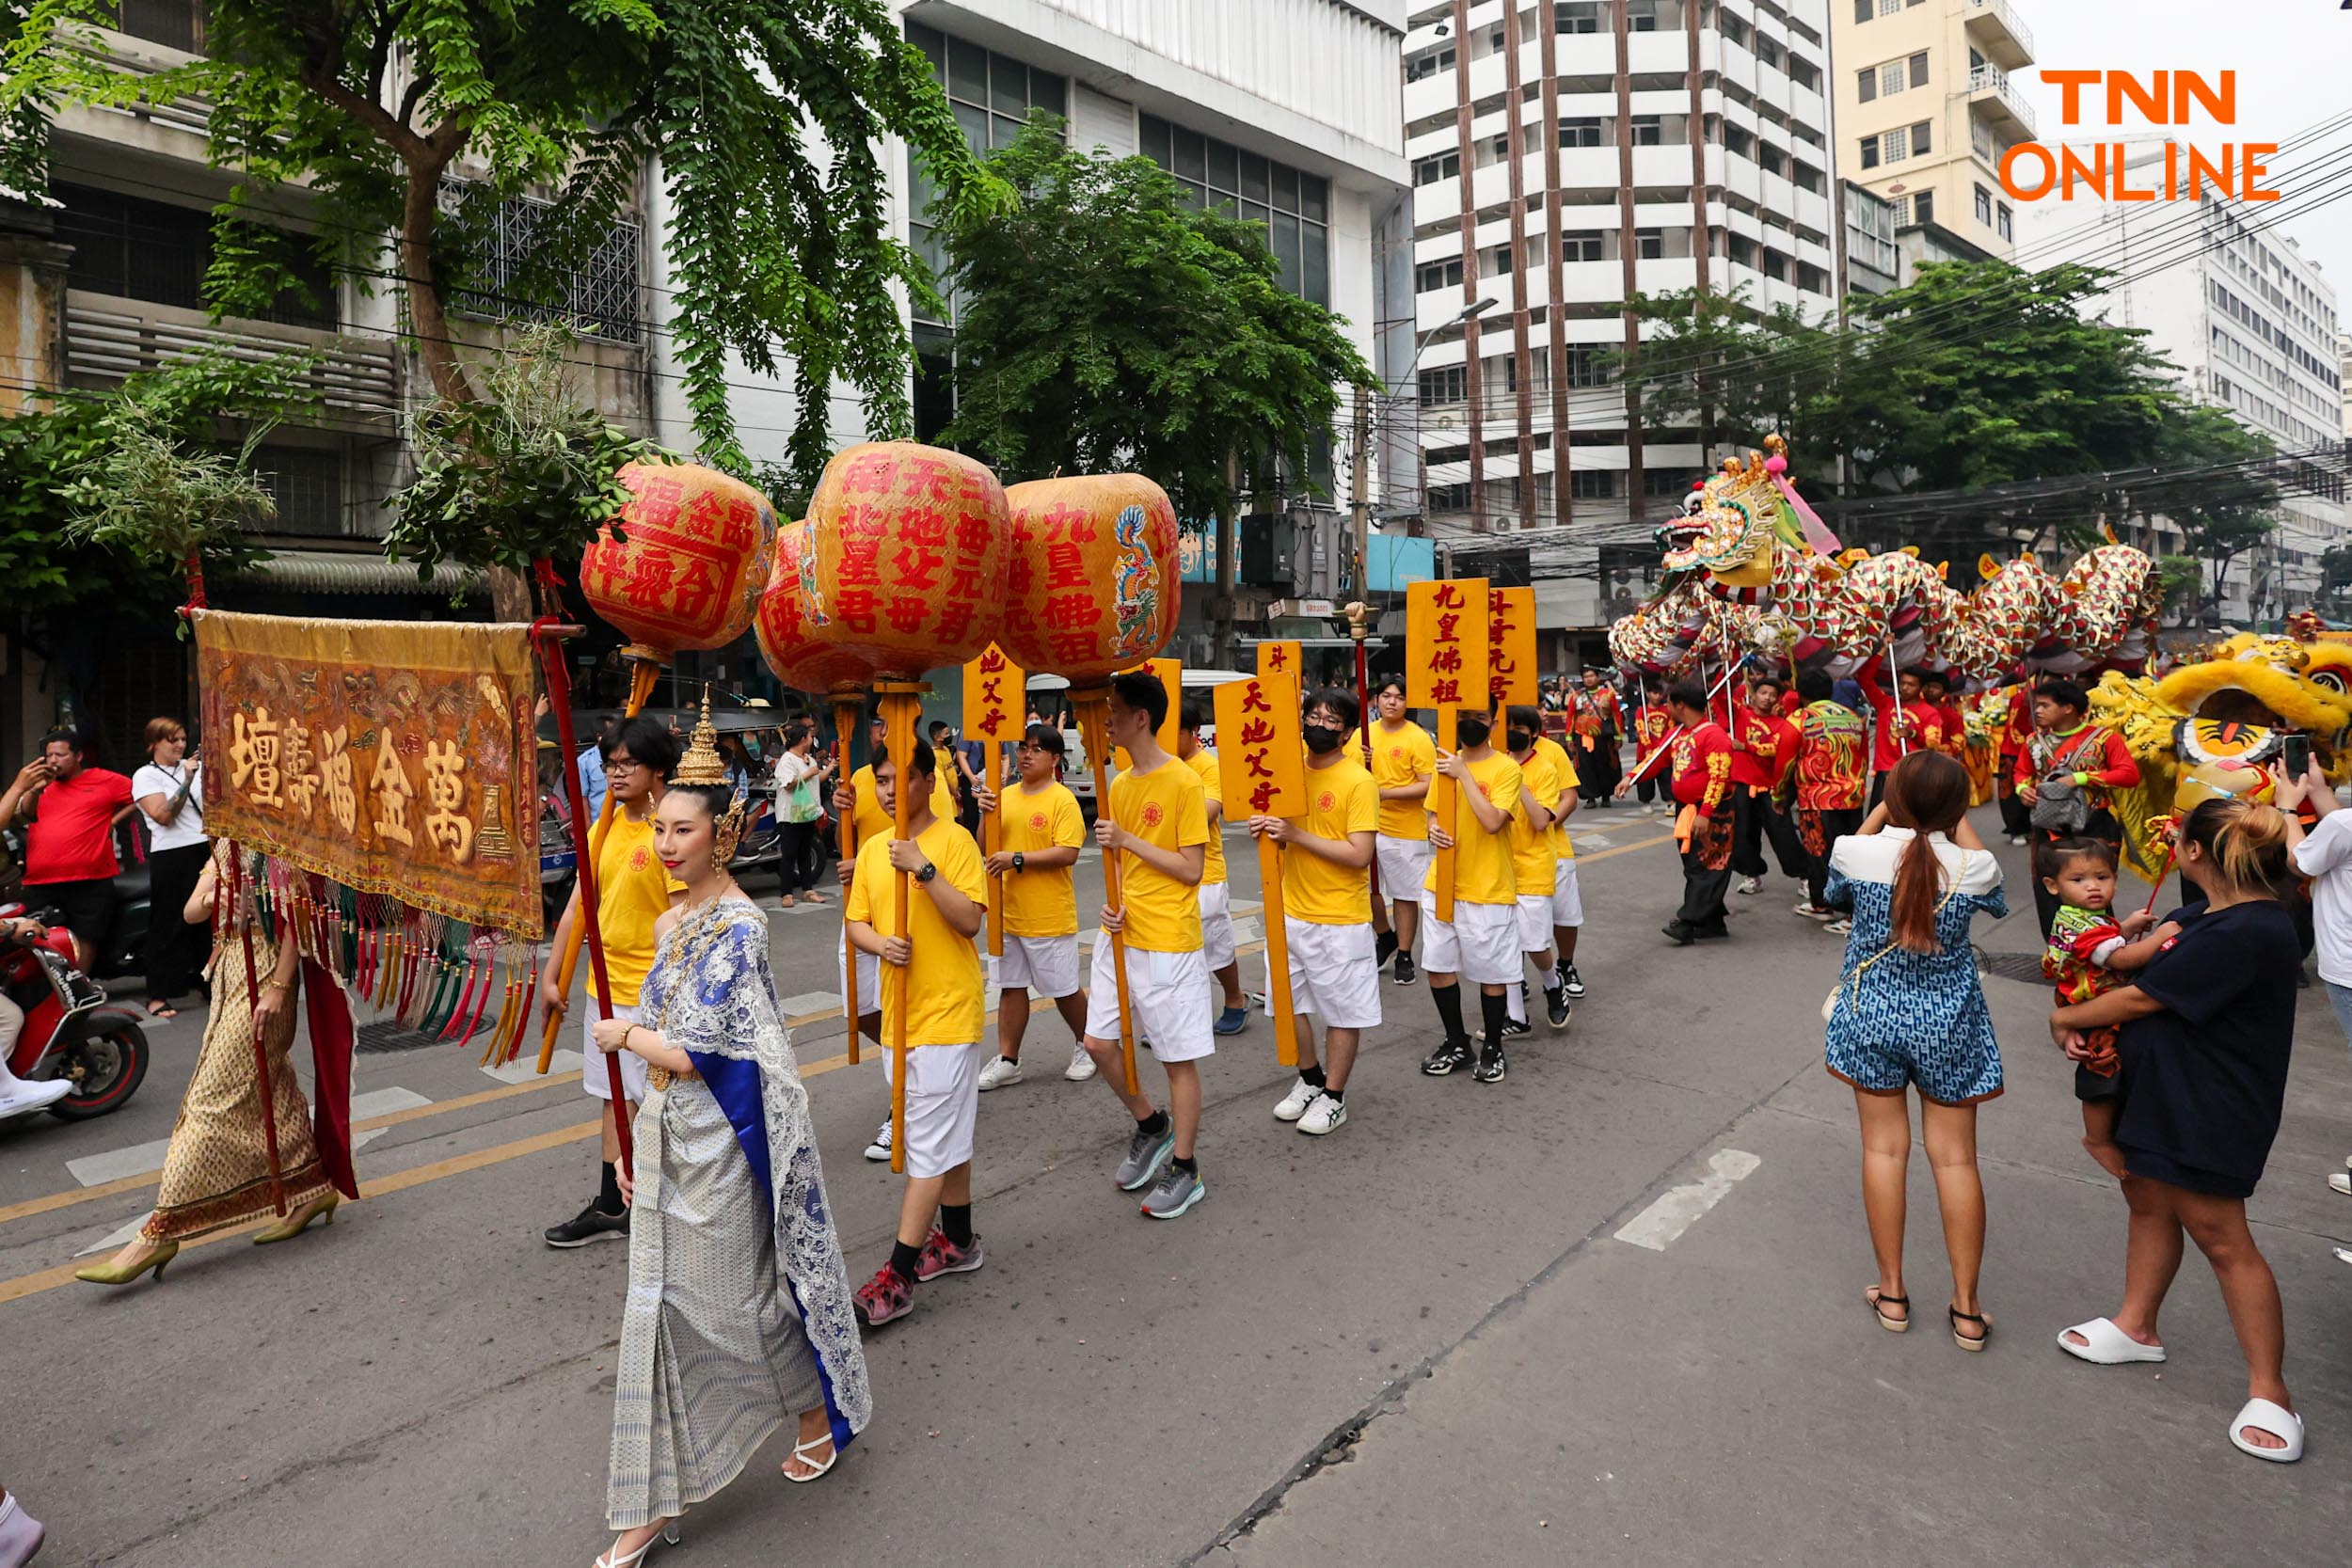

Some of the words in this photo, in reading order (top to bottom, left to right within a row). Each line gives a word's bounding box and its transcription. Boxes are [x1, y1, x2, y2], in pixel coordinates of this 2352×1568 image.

[885, 457, 951, 634] 天地父母
[1428, 584, 1466, 705] 九皇佛祖
[1241, 681, 1281, 813] 天地父母
